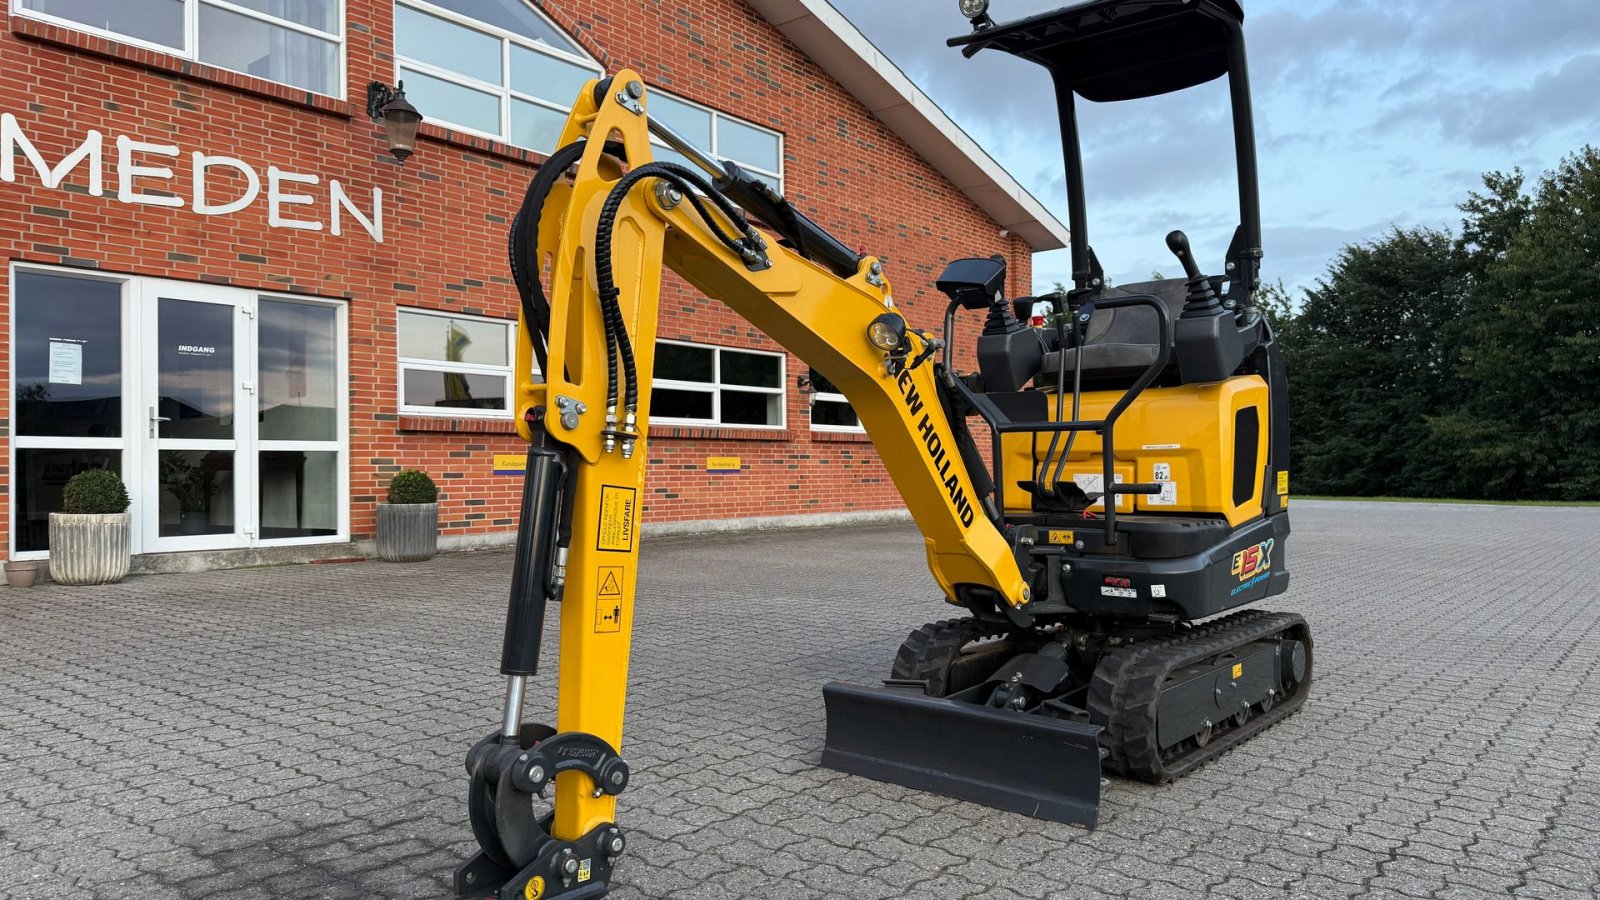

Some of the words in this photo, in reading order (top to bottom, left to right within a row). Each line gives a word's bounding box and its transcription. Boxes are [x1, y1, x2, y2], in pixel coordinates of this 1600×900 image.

[178, 345, 215, 353] INDGANG
[918, 413, 974, 529] HOLLAND
[1154, 471, 1164, 480] 82
[622, 499, 631, 540] LIVSFARE
[1232, 538, 1274, 581] E15X
